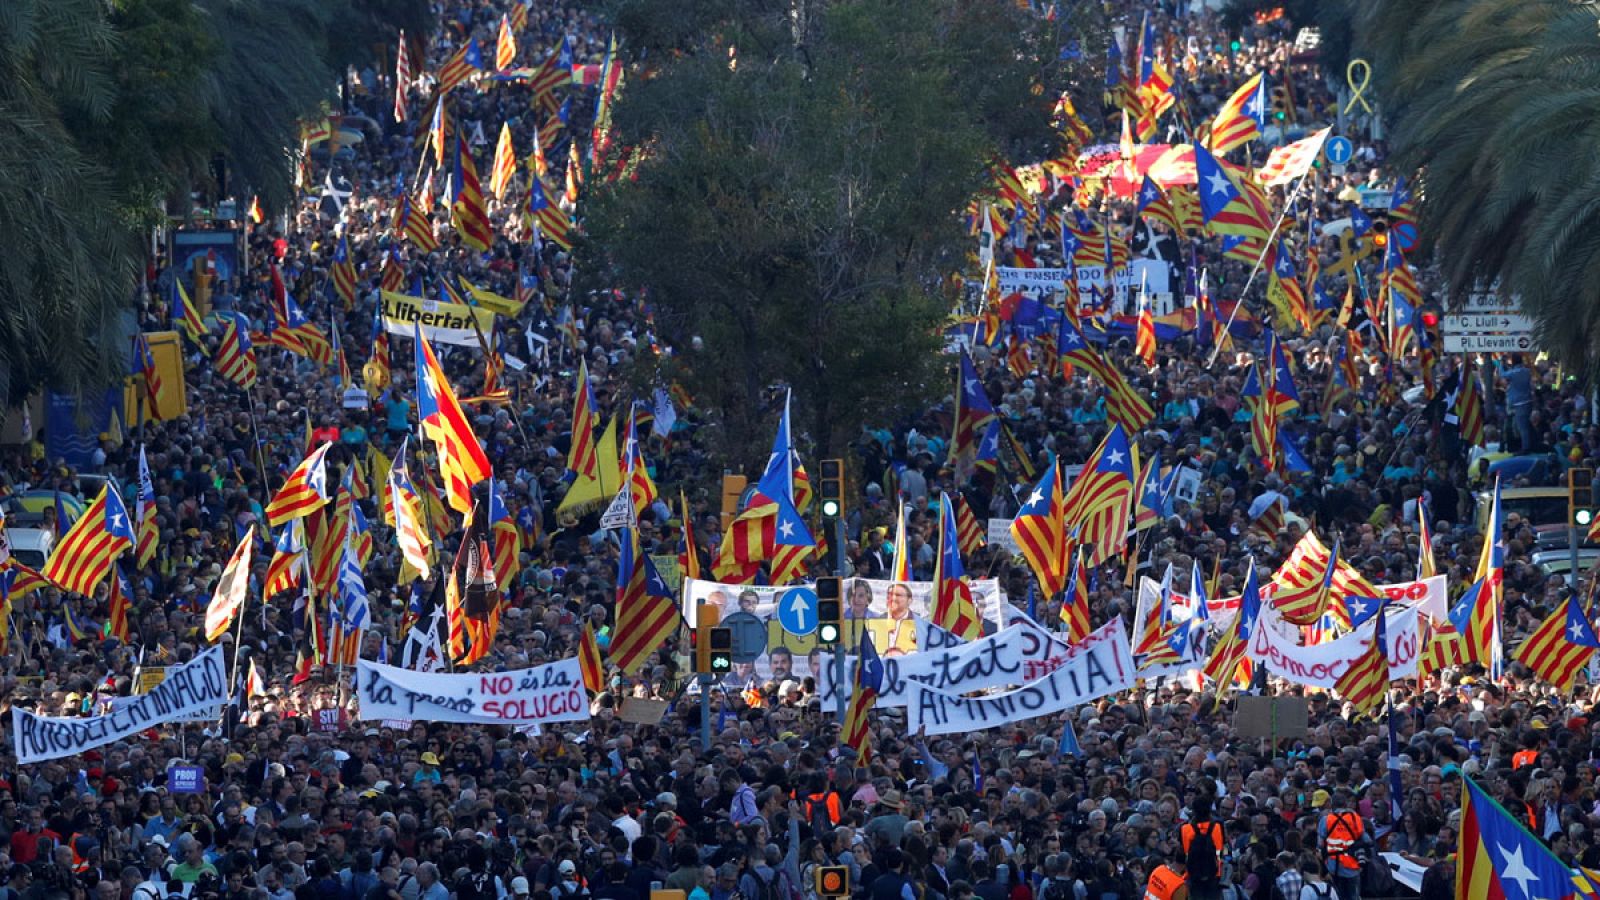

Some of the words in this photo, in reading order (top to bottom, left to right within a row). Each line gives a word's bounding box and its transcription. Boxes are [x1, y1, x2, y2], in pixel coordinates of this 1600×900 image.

[1461, 317, 1472, 328] C.
[1475, 317, 1498, 328] Llull
[1461, 338, 1474, 348] Pl.
[1477, 338, 1515, 348] Llevant
[480, 676, 513, 695] NO
[518, 675, 539, 692] és
[542, 665, 571, 689] la
